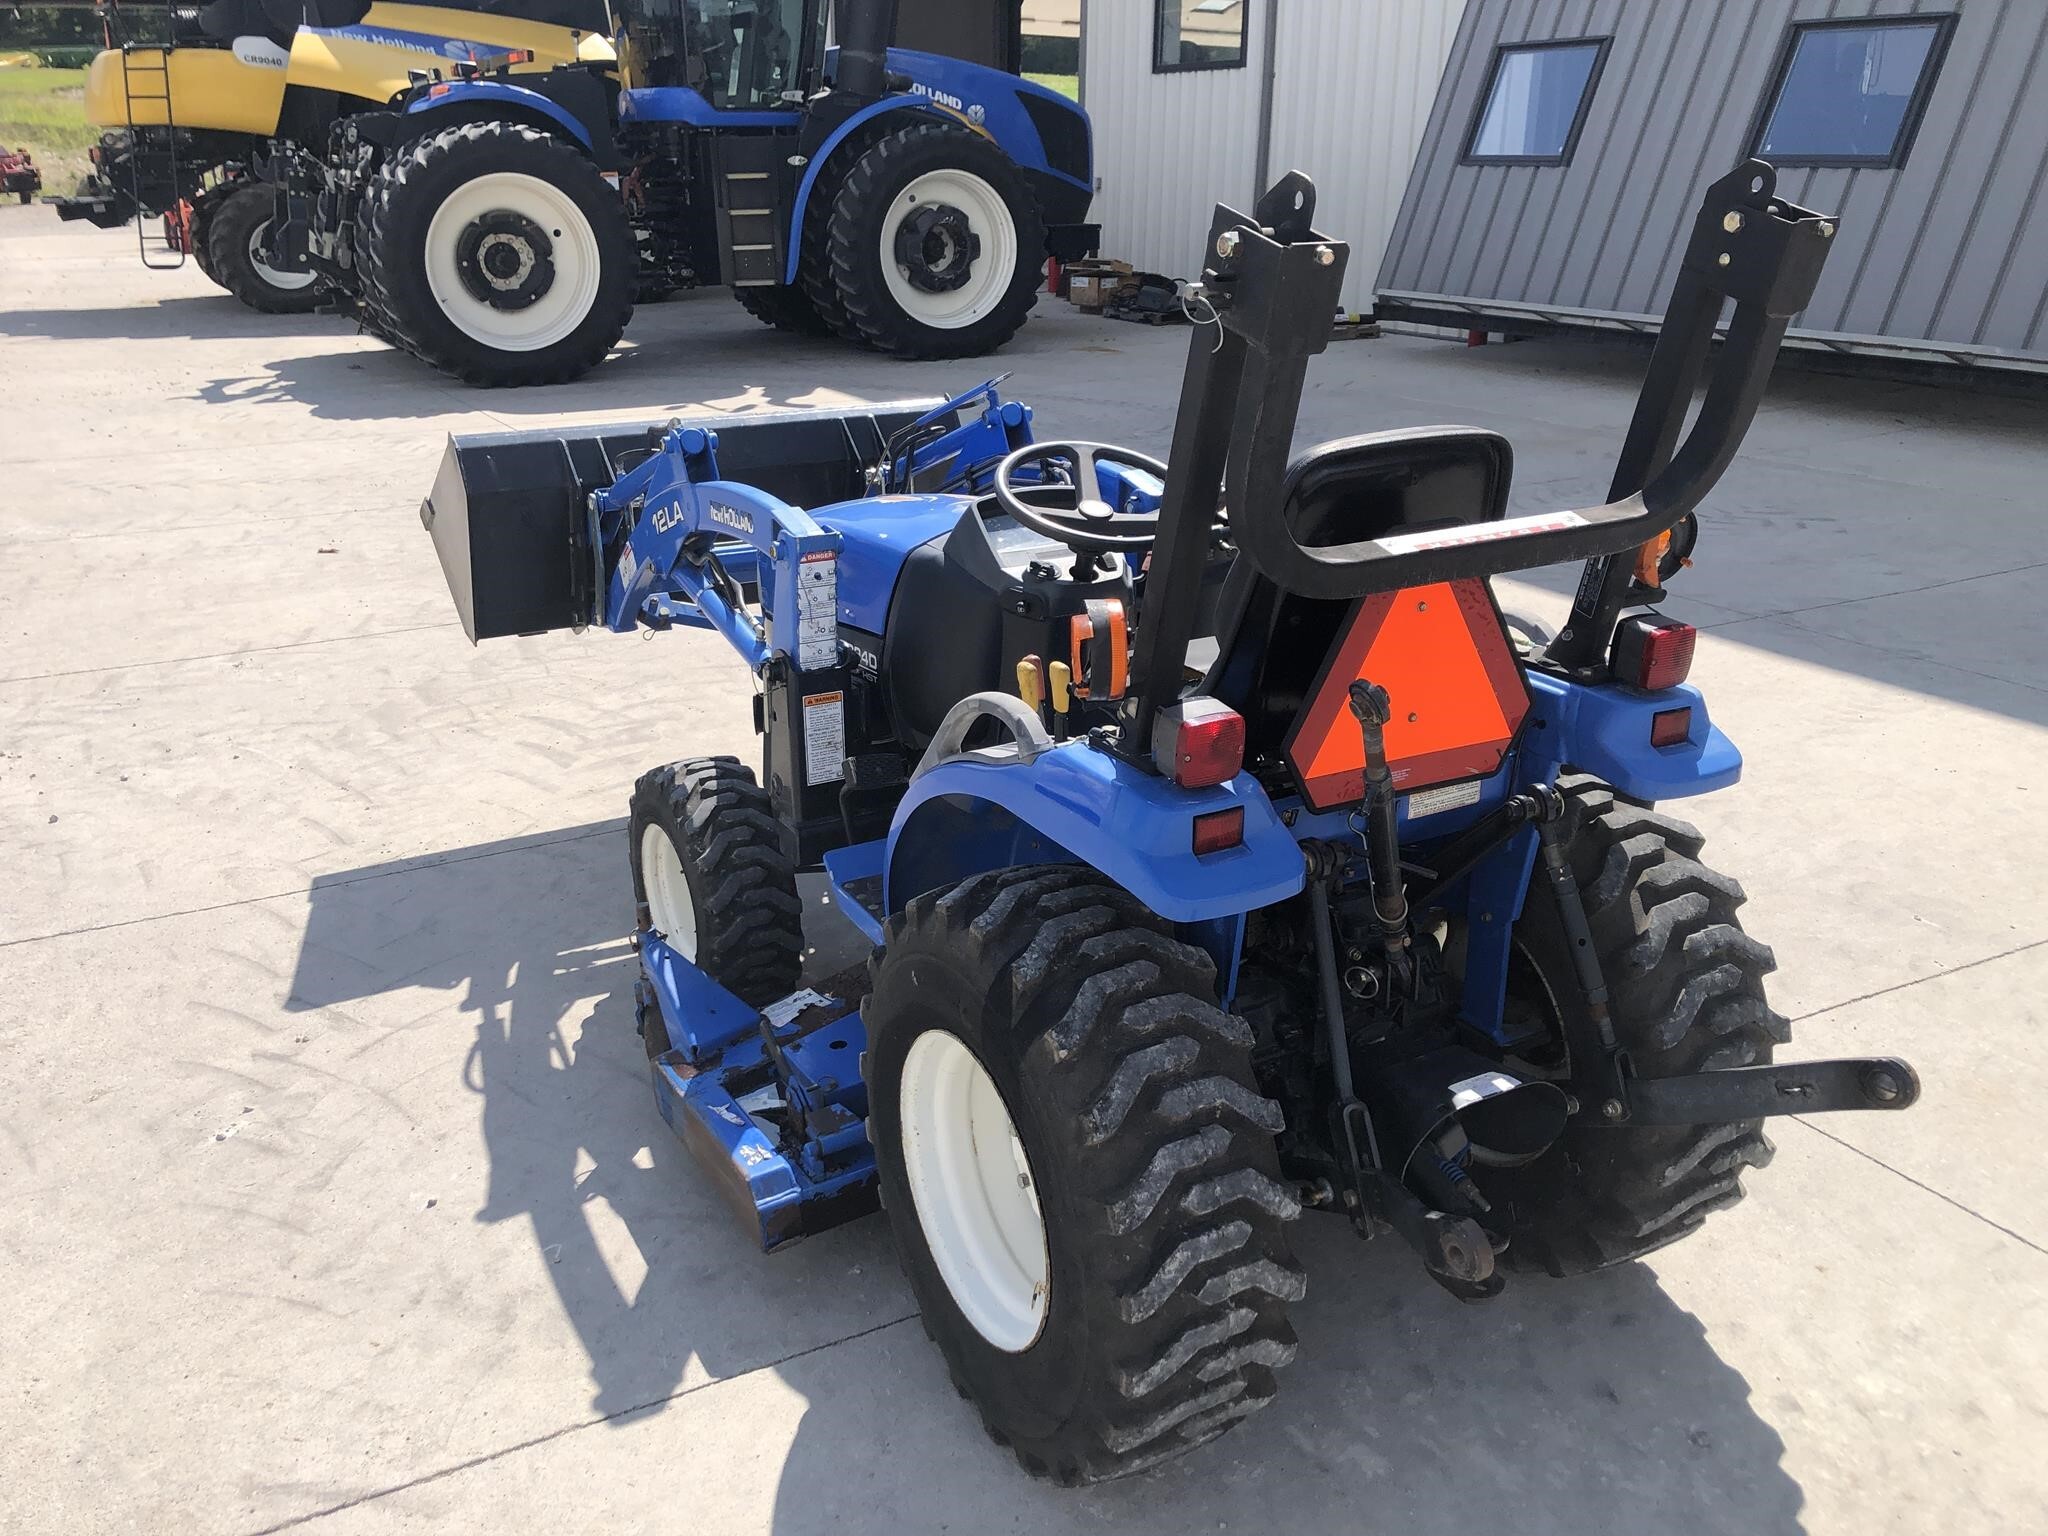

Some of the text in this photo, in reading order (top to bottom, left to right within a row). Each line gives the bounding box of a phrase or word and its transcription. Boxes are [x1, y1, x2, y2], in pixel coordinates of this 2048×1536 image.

[330, 28, 437, 56] New Holland
[243, 54, 283, 67] CR9040
[908, 82, 963, 111] OLLAND
[652, 500, 684, 535] 12LA
[807, 552, 834, 561] DANGER
[862, 670, 878, 684] HST
[813, 694, 839, 703] WARNING
